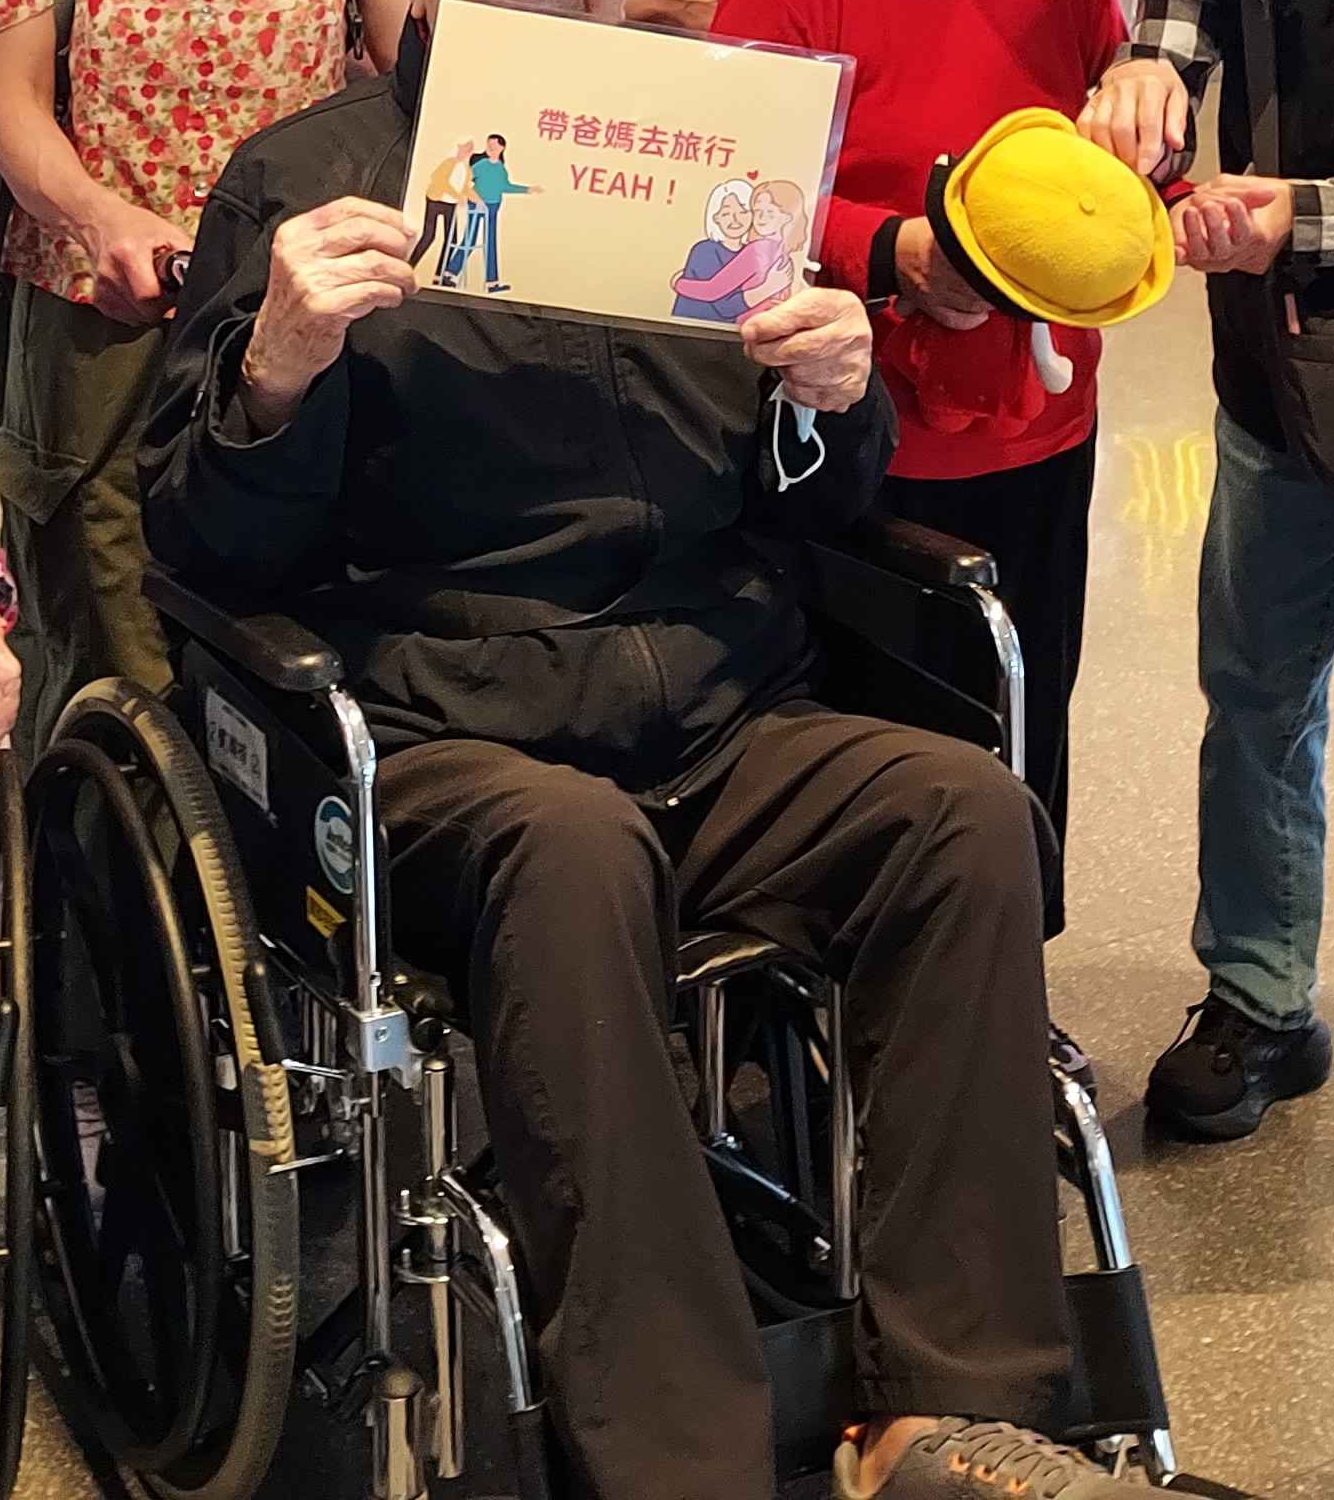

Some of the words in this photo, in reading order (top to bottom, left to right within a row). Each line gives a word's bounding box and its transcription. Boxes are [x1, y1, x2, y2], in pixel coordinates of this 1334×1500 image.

[537, 108, 737, 168] 帶爸媽去旅行
